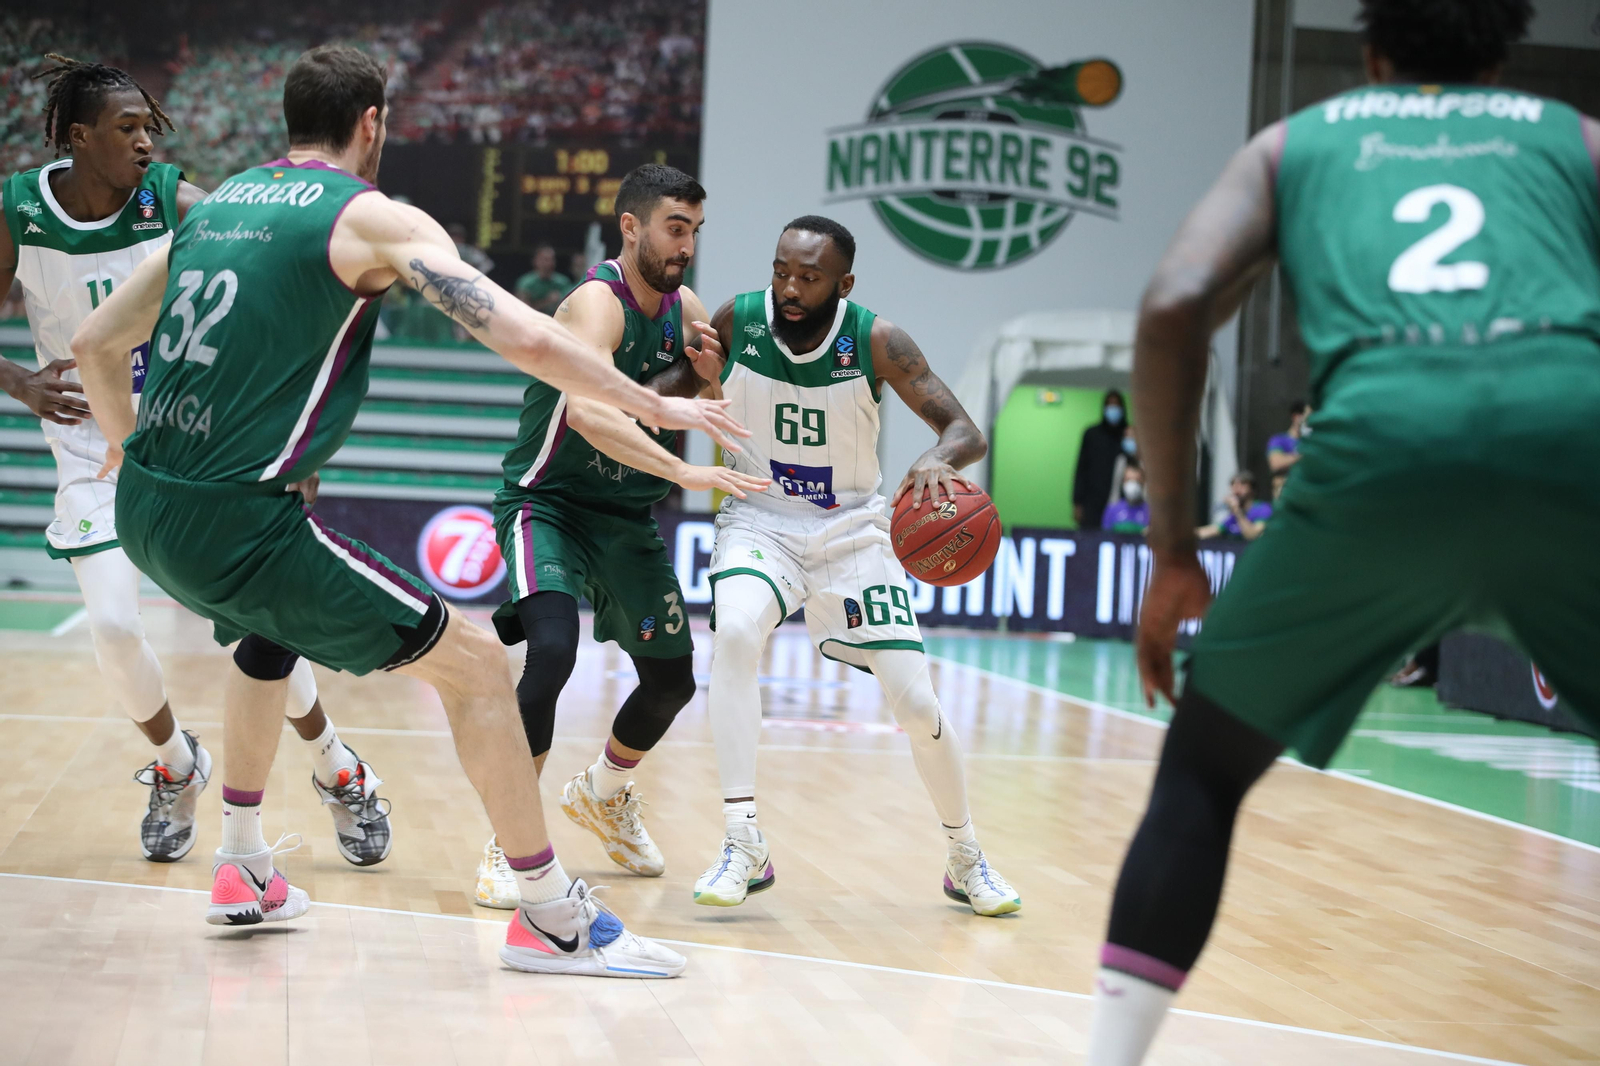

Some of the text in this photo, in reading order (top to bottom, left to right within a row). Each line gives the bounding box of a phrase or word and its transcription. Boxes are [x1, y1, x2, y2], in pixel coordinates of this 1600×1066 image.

[1323, 91, 1544, 124] THOMPSON
[826, 128, 1120, 208] NANTERRE 92
[202, 180, 325, 208] GUERRERO
[1387, 183, 1490, 294] 2
[158, 269, 239, 367] 32
[774, 402, 826, 447] 69
[901, 511, 940, 540] EuroCup
[907, 525, 975, 576] SPALDING
[663, 591, 684, 635] 3
[862, 584, 914, 627] 69
